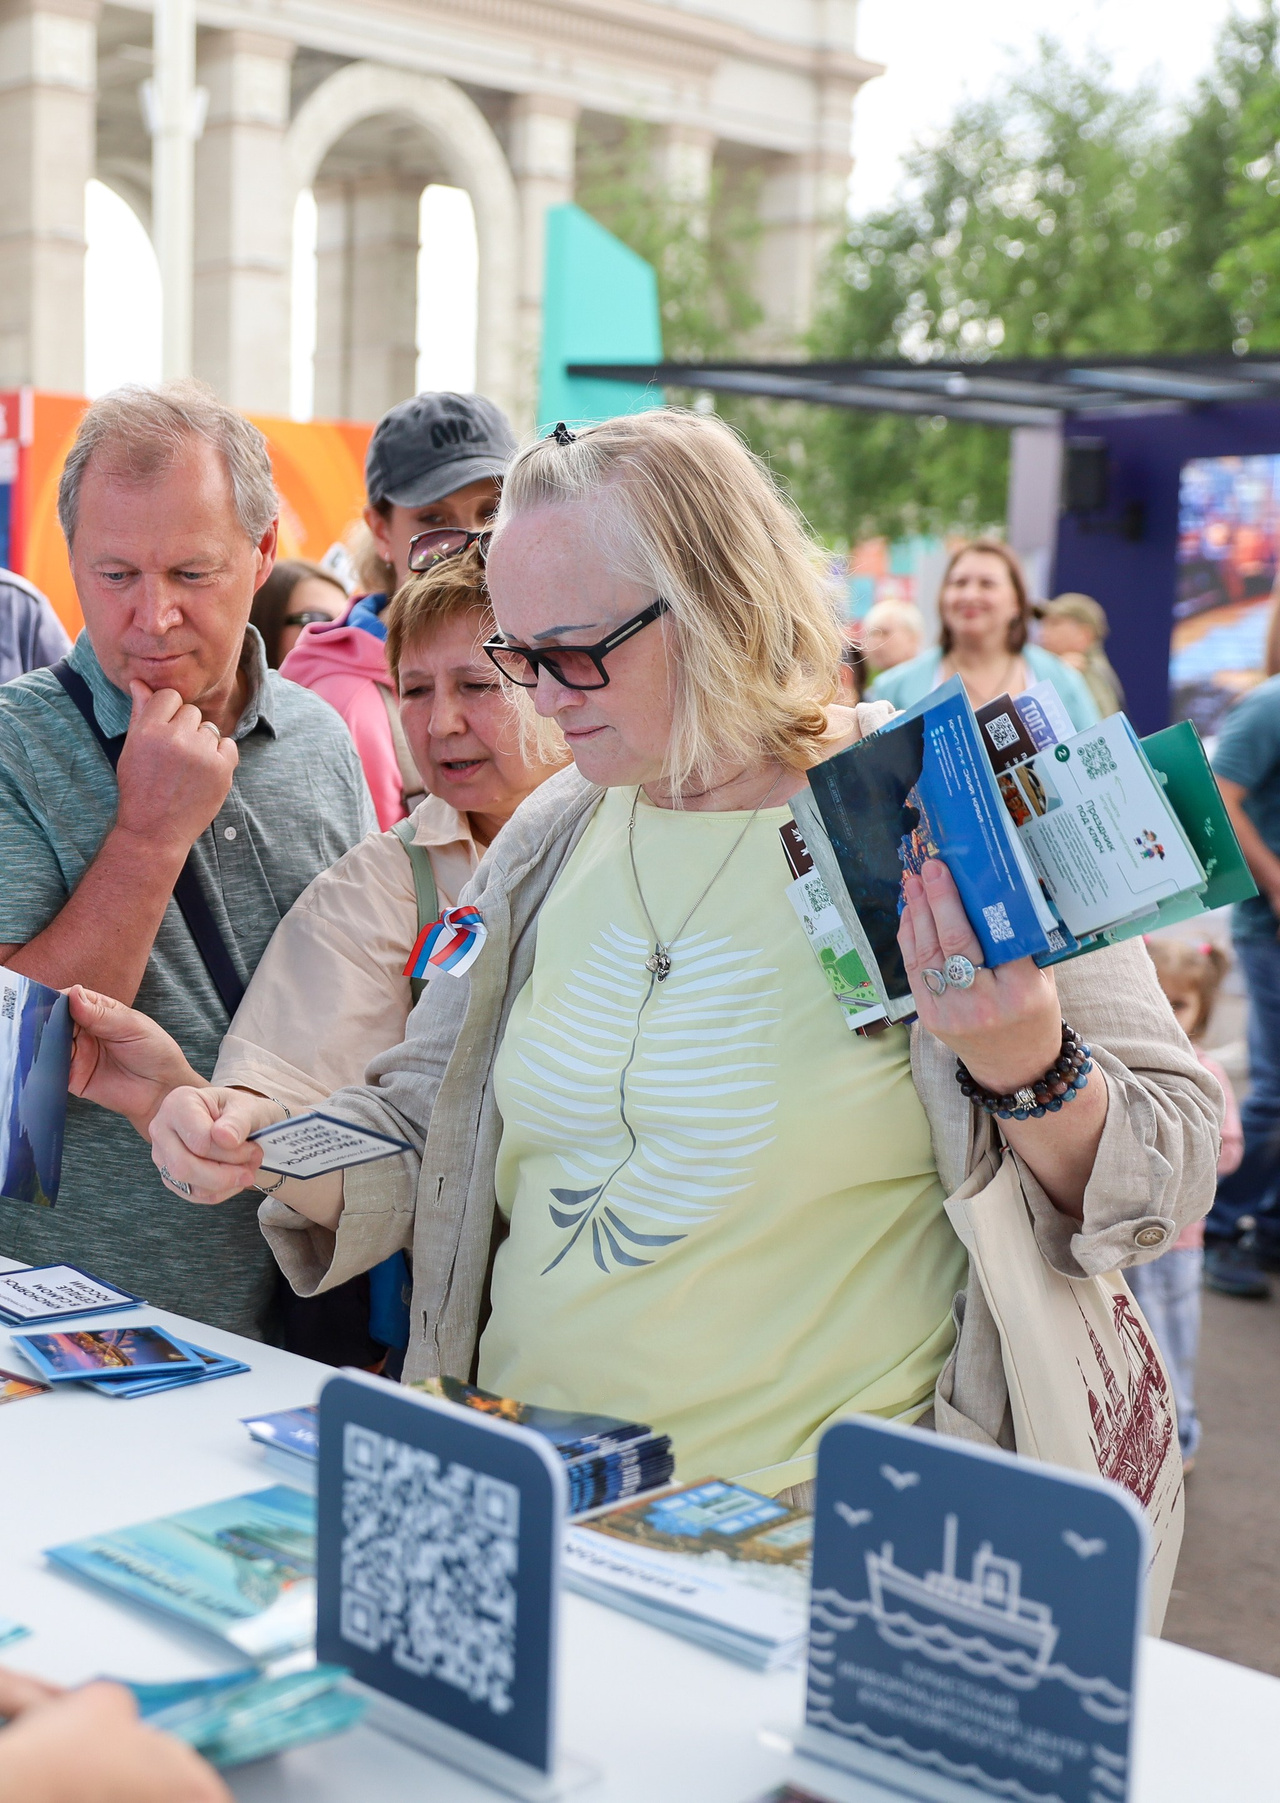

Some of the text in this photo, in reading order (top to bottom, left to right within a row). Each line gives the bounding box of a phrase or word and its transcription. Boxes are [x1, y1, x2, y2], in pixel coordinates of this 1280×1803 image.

[1057, 749, 1067, 759] 2
[1076, 804, 1104, 854] под ключ
[1085, 799, 1116, 852] Праздник
[32, 1283, 74, 1304] САМОМ
[55, 1285, 98, 1304] СЕРДЦЕ
[68, 1280, 115, 1301] РОССИИ
